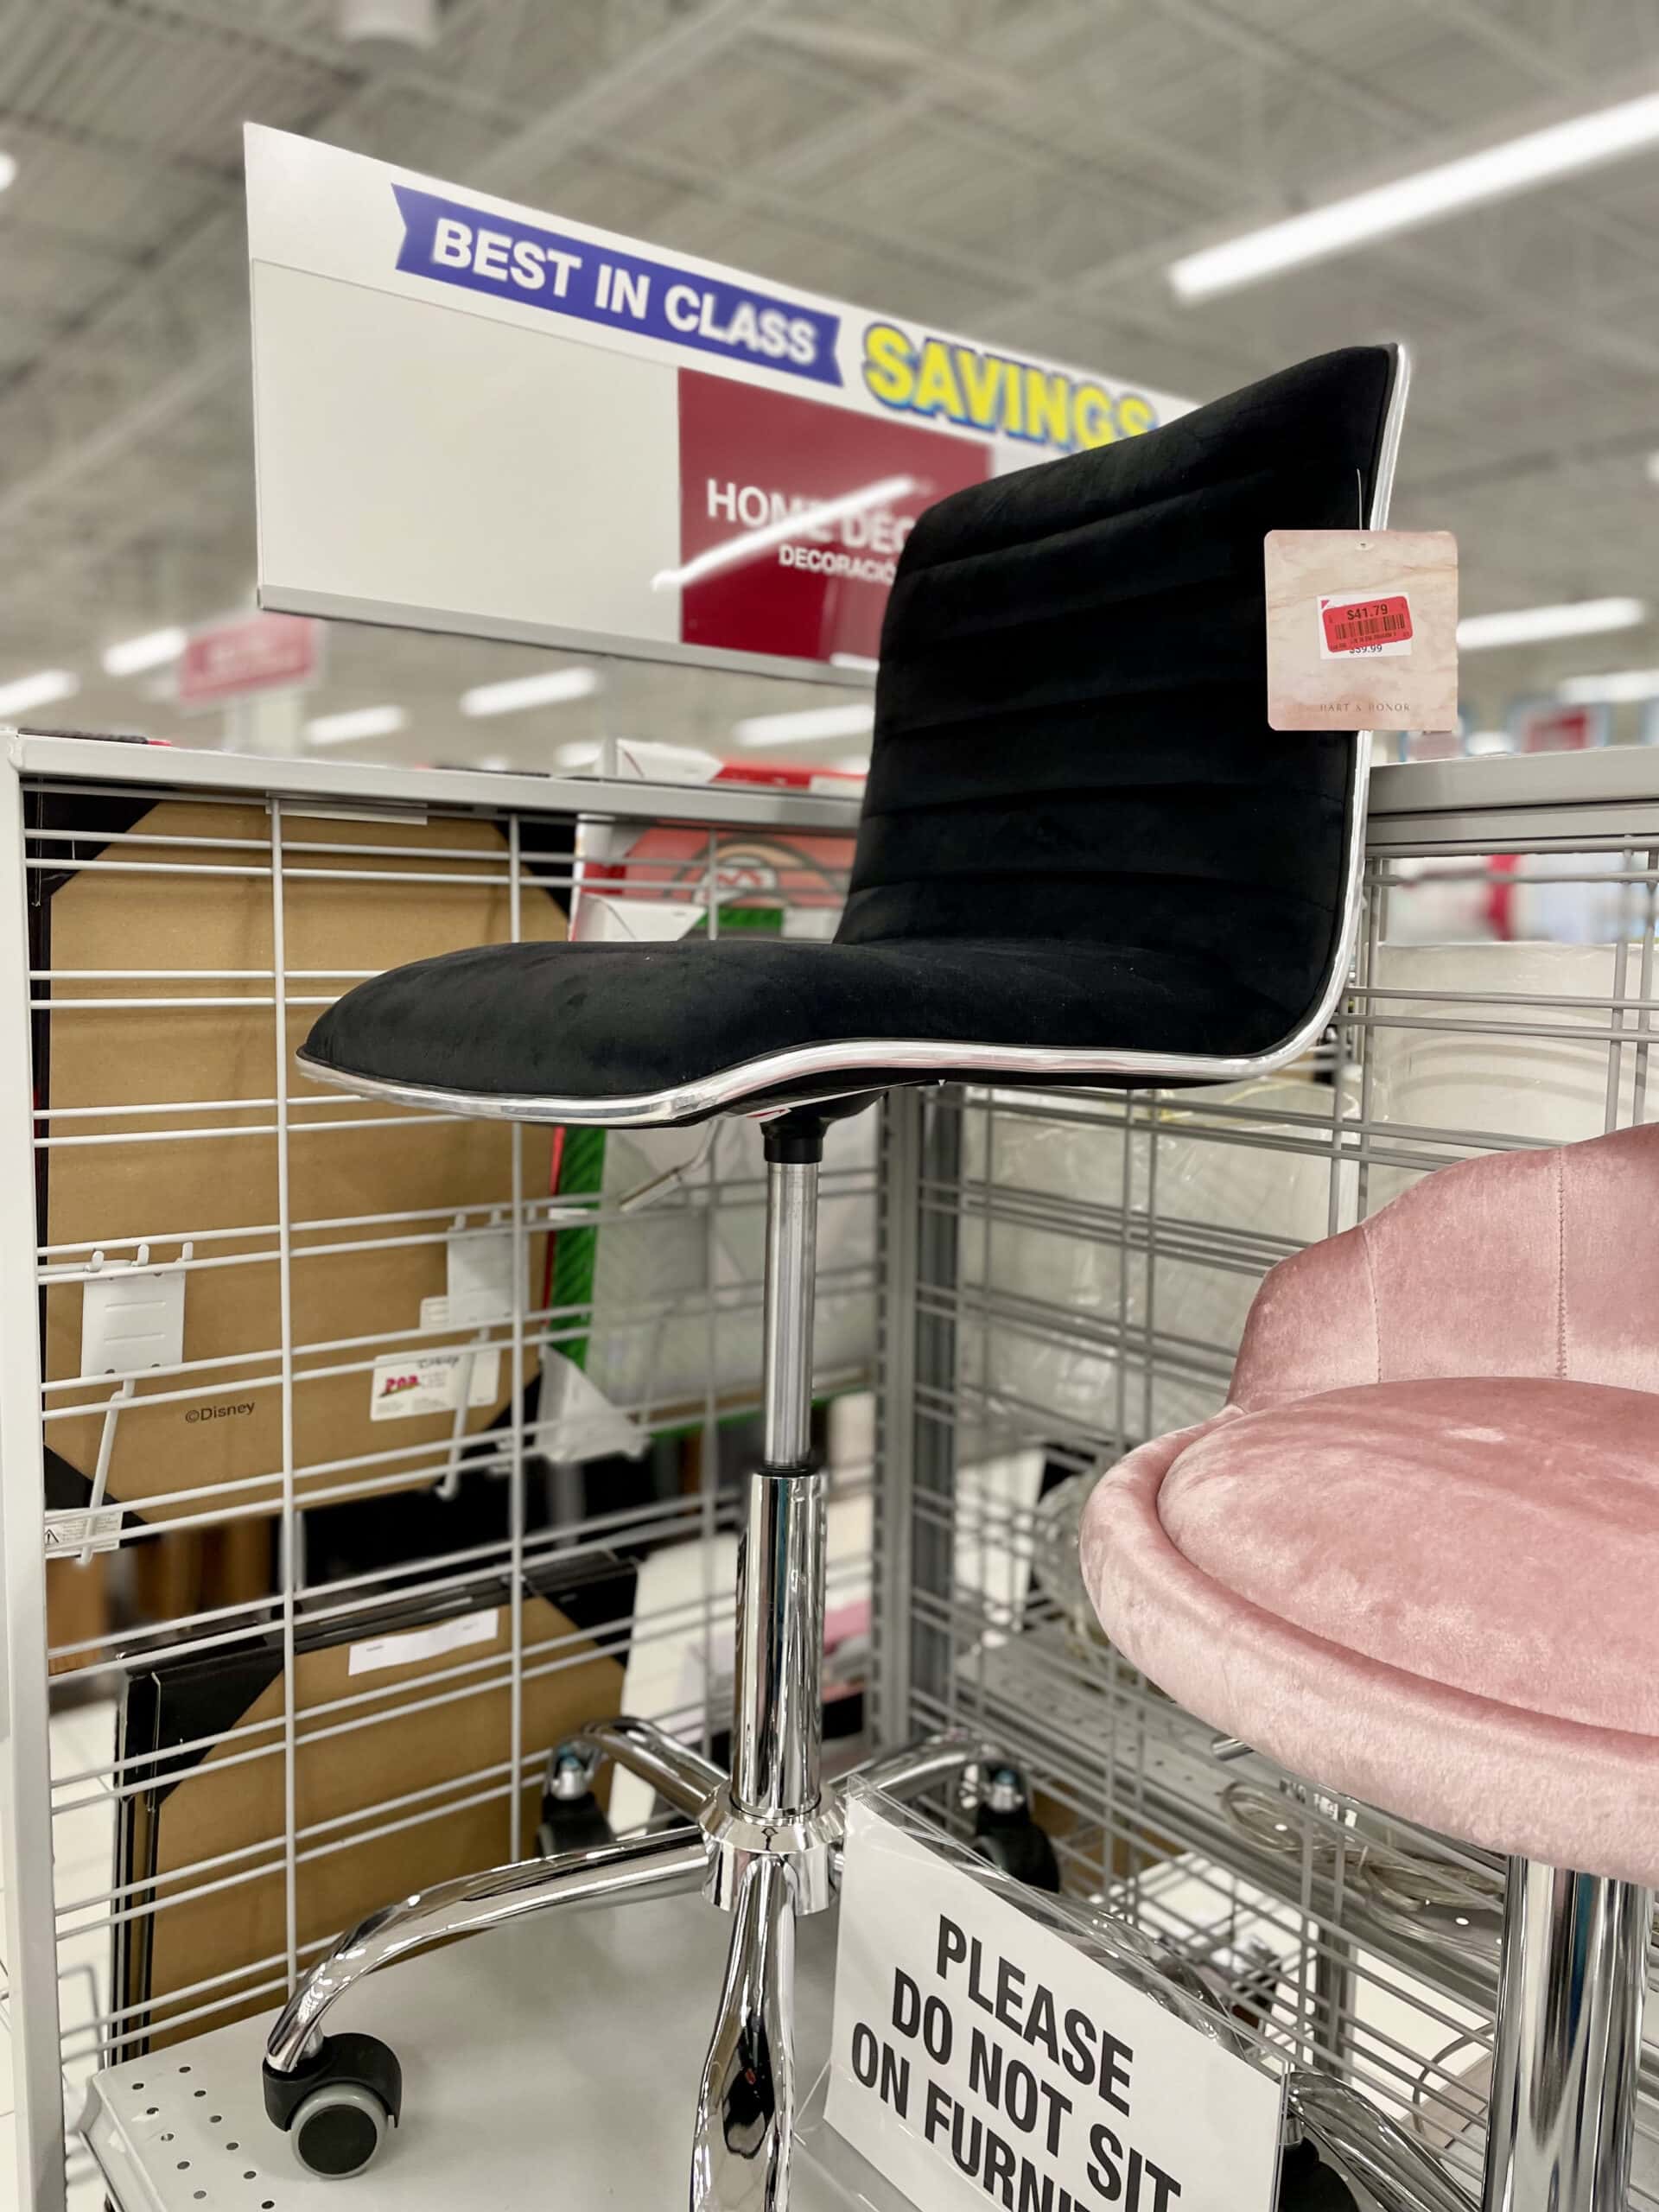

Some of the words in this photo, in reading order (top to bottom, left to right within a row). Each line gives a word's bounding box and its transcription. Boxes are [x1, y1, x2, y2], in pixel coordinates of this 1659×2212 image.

[432, 218, 582, 297] BEST
[594, 264, 651, 319] IN
[664, 285, 817, 365] CLASS
[862, 322, 1158, 453] SAVINGS
[779, 543, 897, 587] DECORACIÓ
[1346, 603, 1389, 620] $41.79
[1320, 703, 1350, 712] HART
[1369, 703, 1410, 712] HONOR
[892, 1967, 951, 2065] DO
[969, 2026, 1072, 2158] NOT
[1087, 2123, 1181, 2212] SIT
[936, 1913, 1134, 2117] PLEASE
[851, 2022, 911, 2120] ON
[925, 2079, 1091, 2212] FURN
